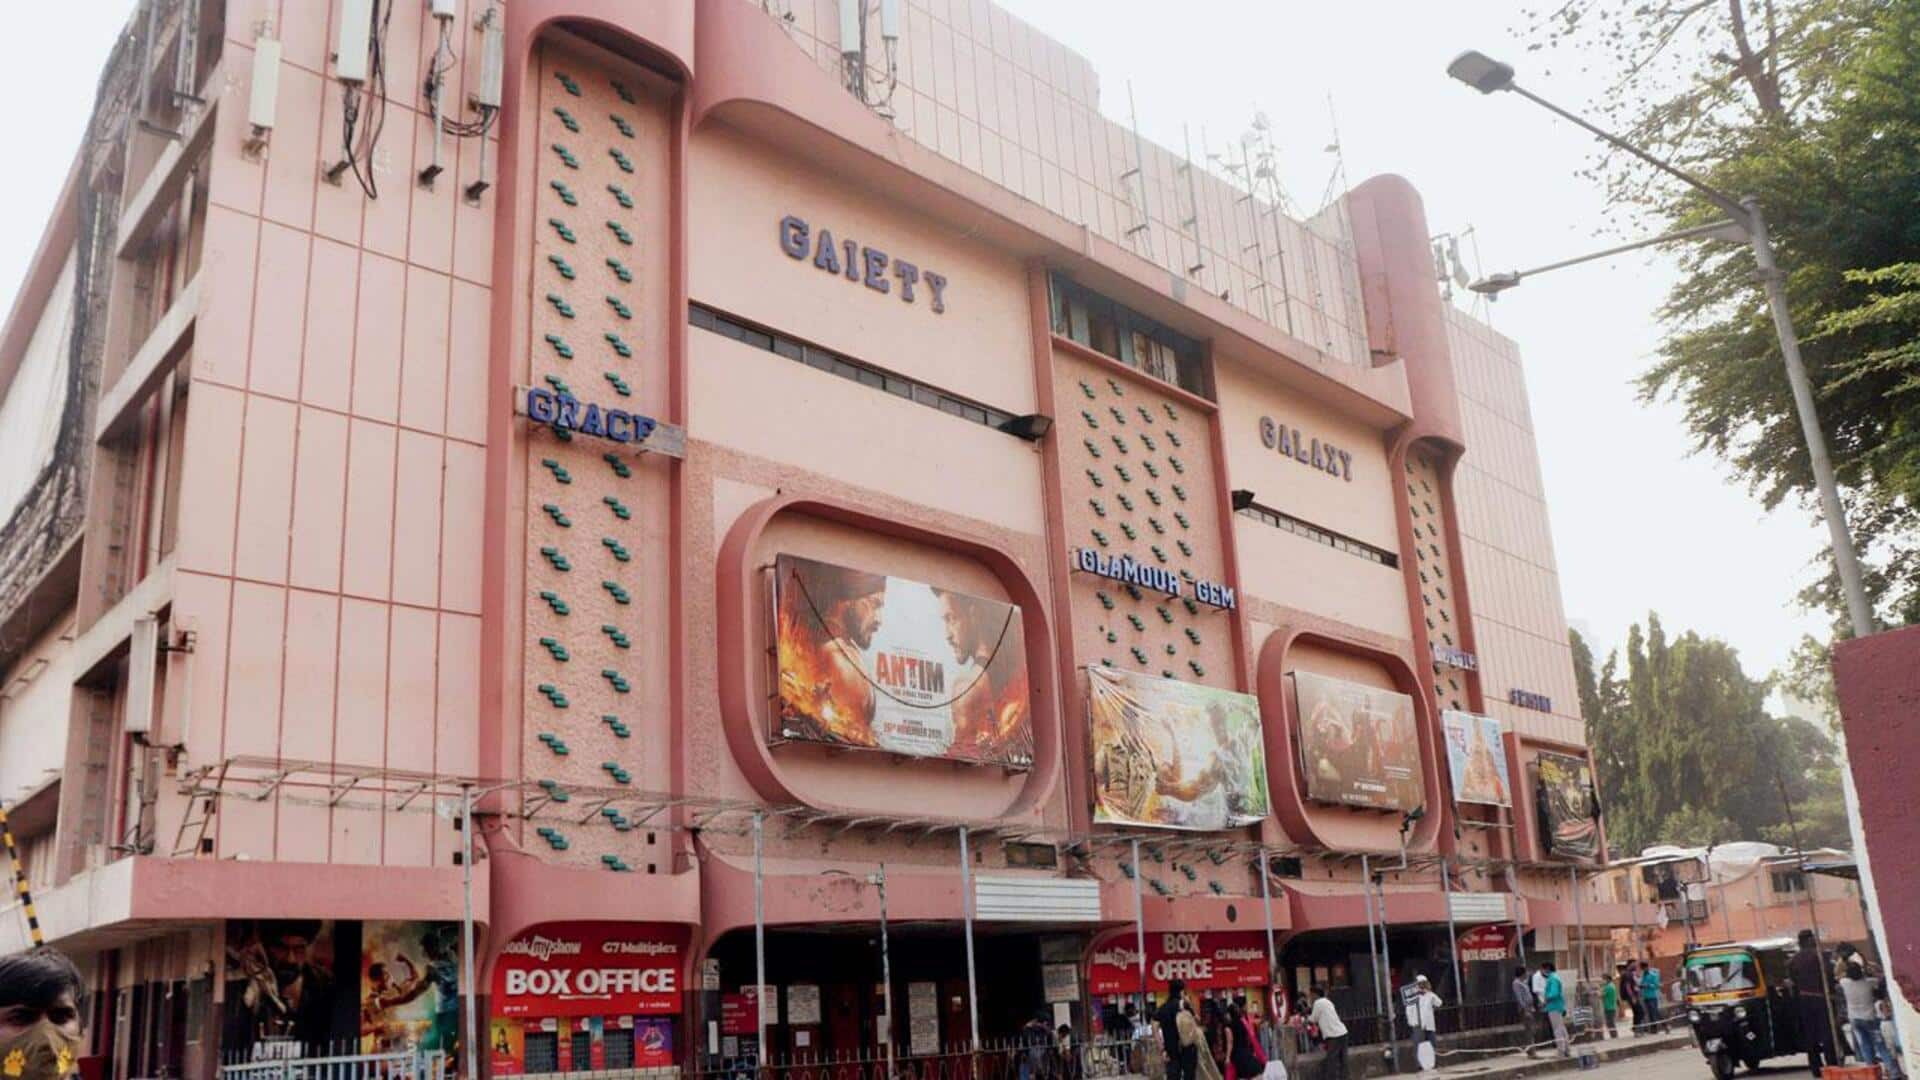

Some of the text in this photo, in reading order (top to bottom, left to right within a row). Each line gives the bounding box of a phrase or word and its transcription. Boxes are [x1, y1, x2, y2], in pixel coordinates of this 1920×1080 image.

[780, 215, 947, 314] GAIETY
[1259, 415, 1352, 482] GALAXY
[1080, 548, 1235, 609] GLAMOUR GEM
[876, 651, 945, 693] ANTIM
[1163, 933, 1200, 954] BOX
[506, 968, 571, 995] BOX
[575, 967, 676, 993] OFFICE
[1151, 958, 1213, 981] OFFICE
